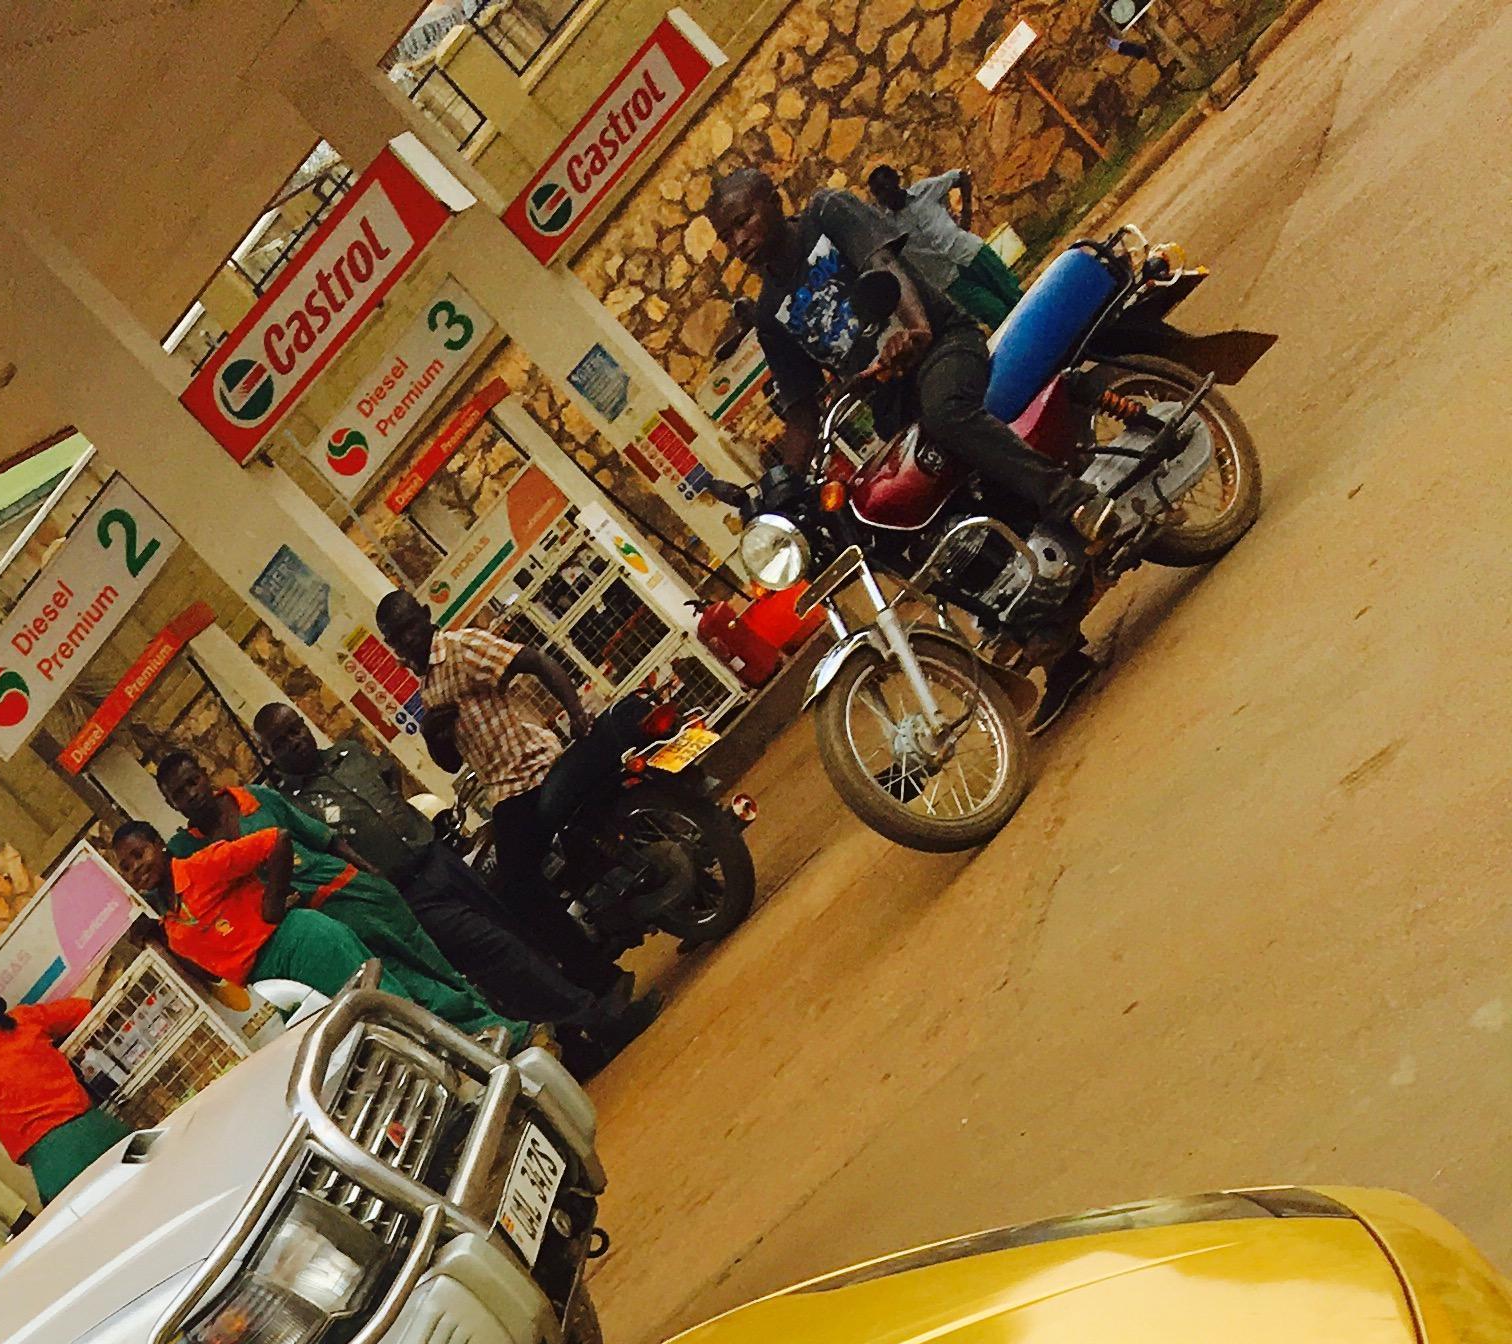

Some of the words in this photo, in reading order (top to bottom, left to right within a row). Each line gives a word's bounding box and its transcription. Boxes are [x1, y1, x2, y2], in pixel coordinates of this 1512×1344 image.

[567, 69, 666, 193] Castrol
[263, 215, 392, 376] Castrol
[428, 300, 474, 352] 3
[357, 356, 409, 419] Diesel
[375, 359, 445, 437] Premium
[96, 507, 161, 578] 2
[10, 579, 75, 657] Diesel
[36, 585, 120, 681] Premium
[70, 724, 106, 766] Diesel
[124, 644, 174, 700] Premium
[520, 1137, 558, 1204] 347S
[508, 1188, 542, 1241] UAL
